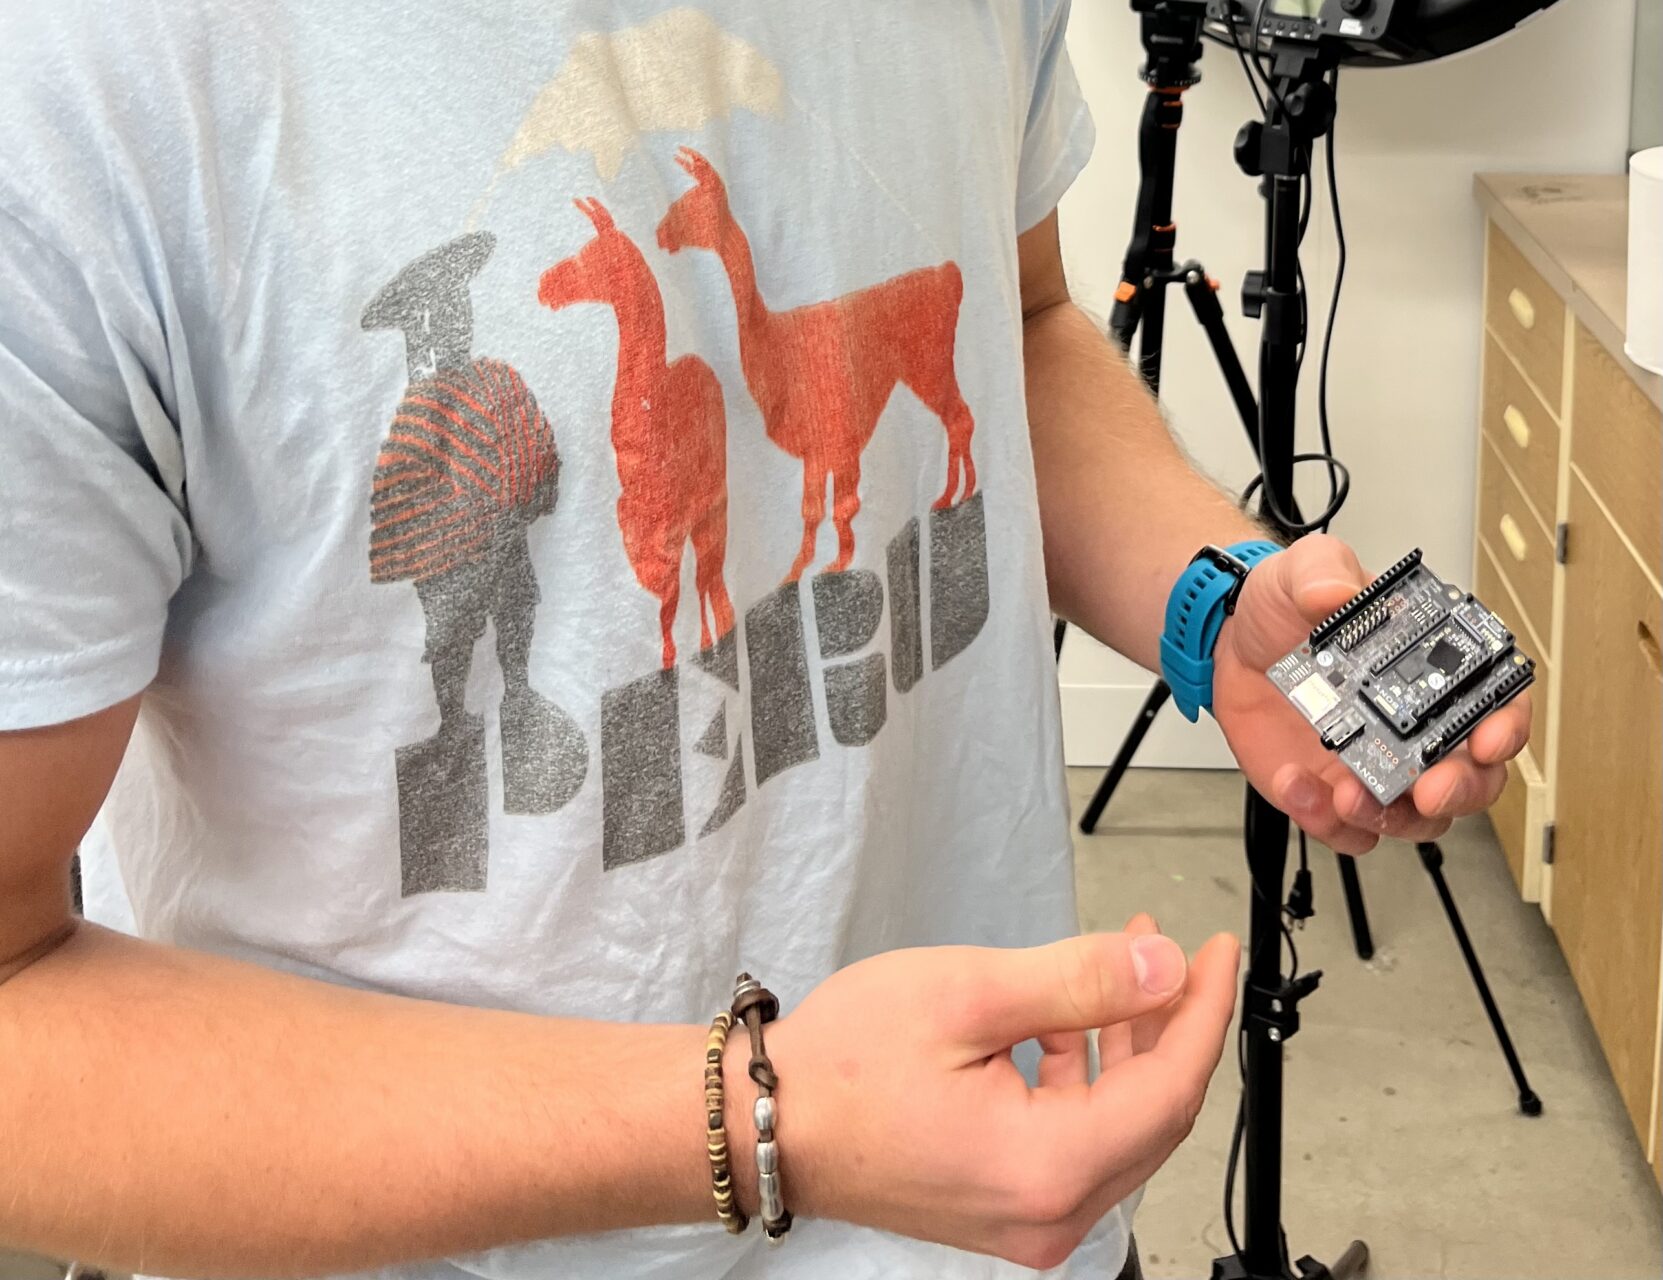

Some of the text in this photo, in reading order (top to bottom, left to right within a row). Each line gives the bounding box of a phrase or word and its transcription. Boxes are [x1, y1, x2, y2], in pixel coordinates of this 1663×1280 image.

[395, 488, 990, 897] PERU
[1374, 684, 1399, 710] SONY
[1353, 760, 1386, 795] SONY
